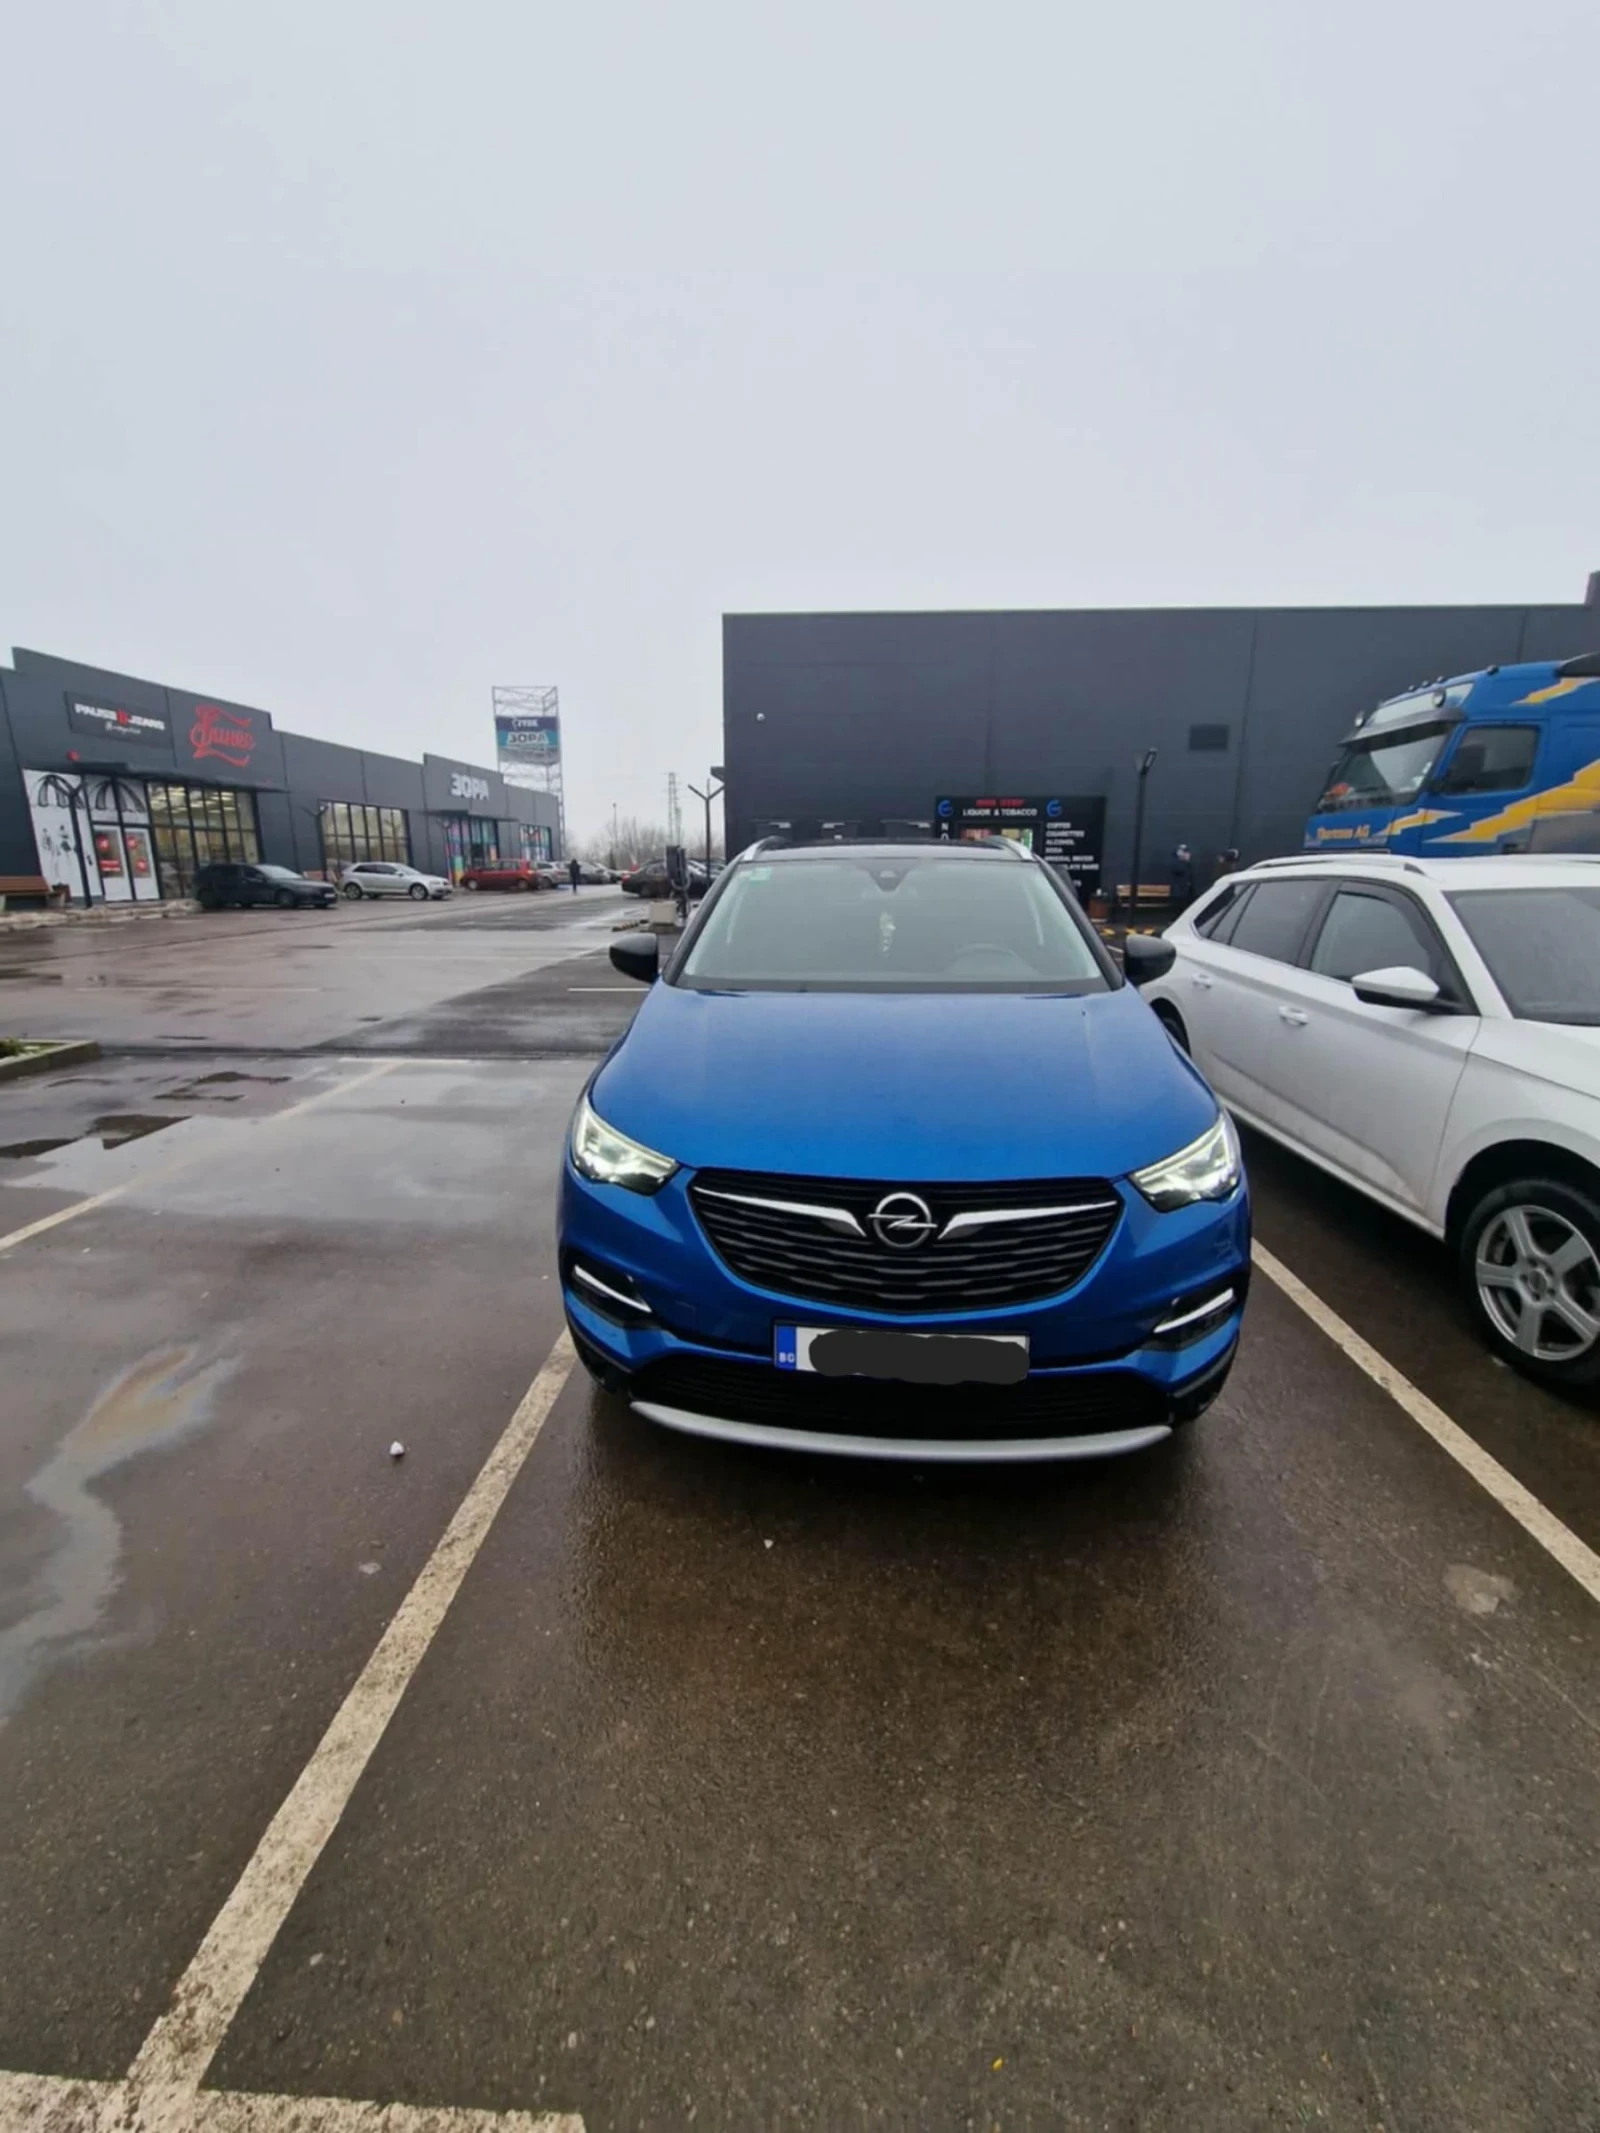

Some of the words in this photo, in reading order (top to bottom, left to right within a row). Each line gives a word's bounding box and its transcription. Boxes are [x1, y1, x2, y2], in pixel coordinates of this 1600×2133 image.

[508, 731, 549, 744] ЗОРА
[450, 773, 490, 801] ЗОРА
[963, 808, 991, 816] LIQUOR
[993, 808, 1000, 816] &
[1001, 808, 1038, 816] TOBACCO
[1046, 830, 1085, 838] CIGARETTES
[779, 1352, 795, 1363] BG
